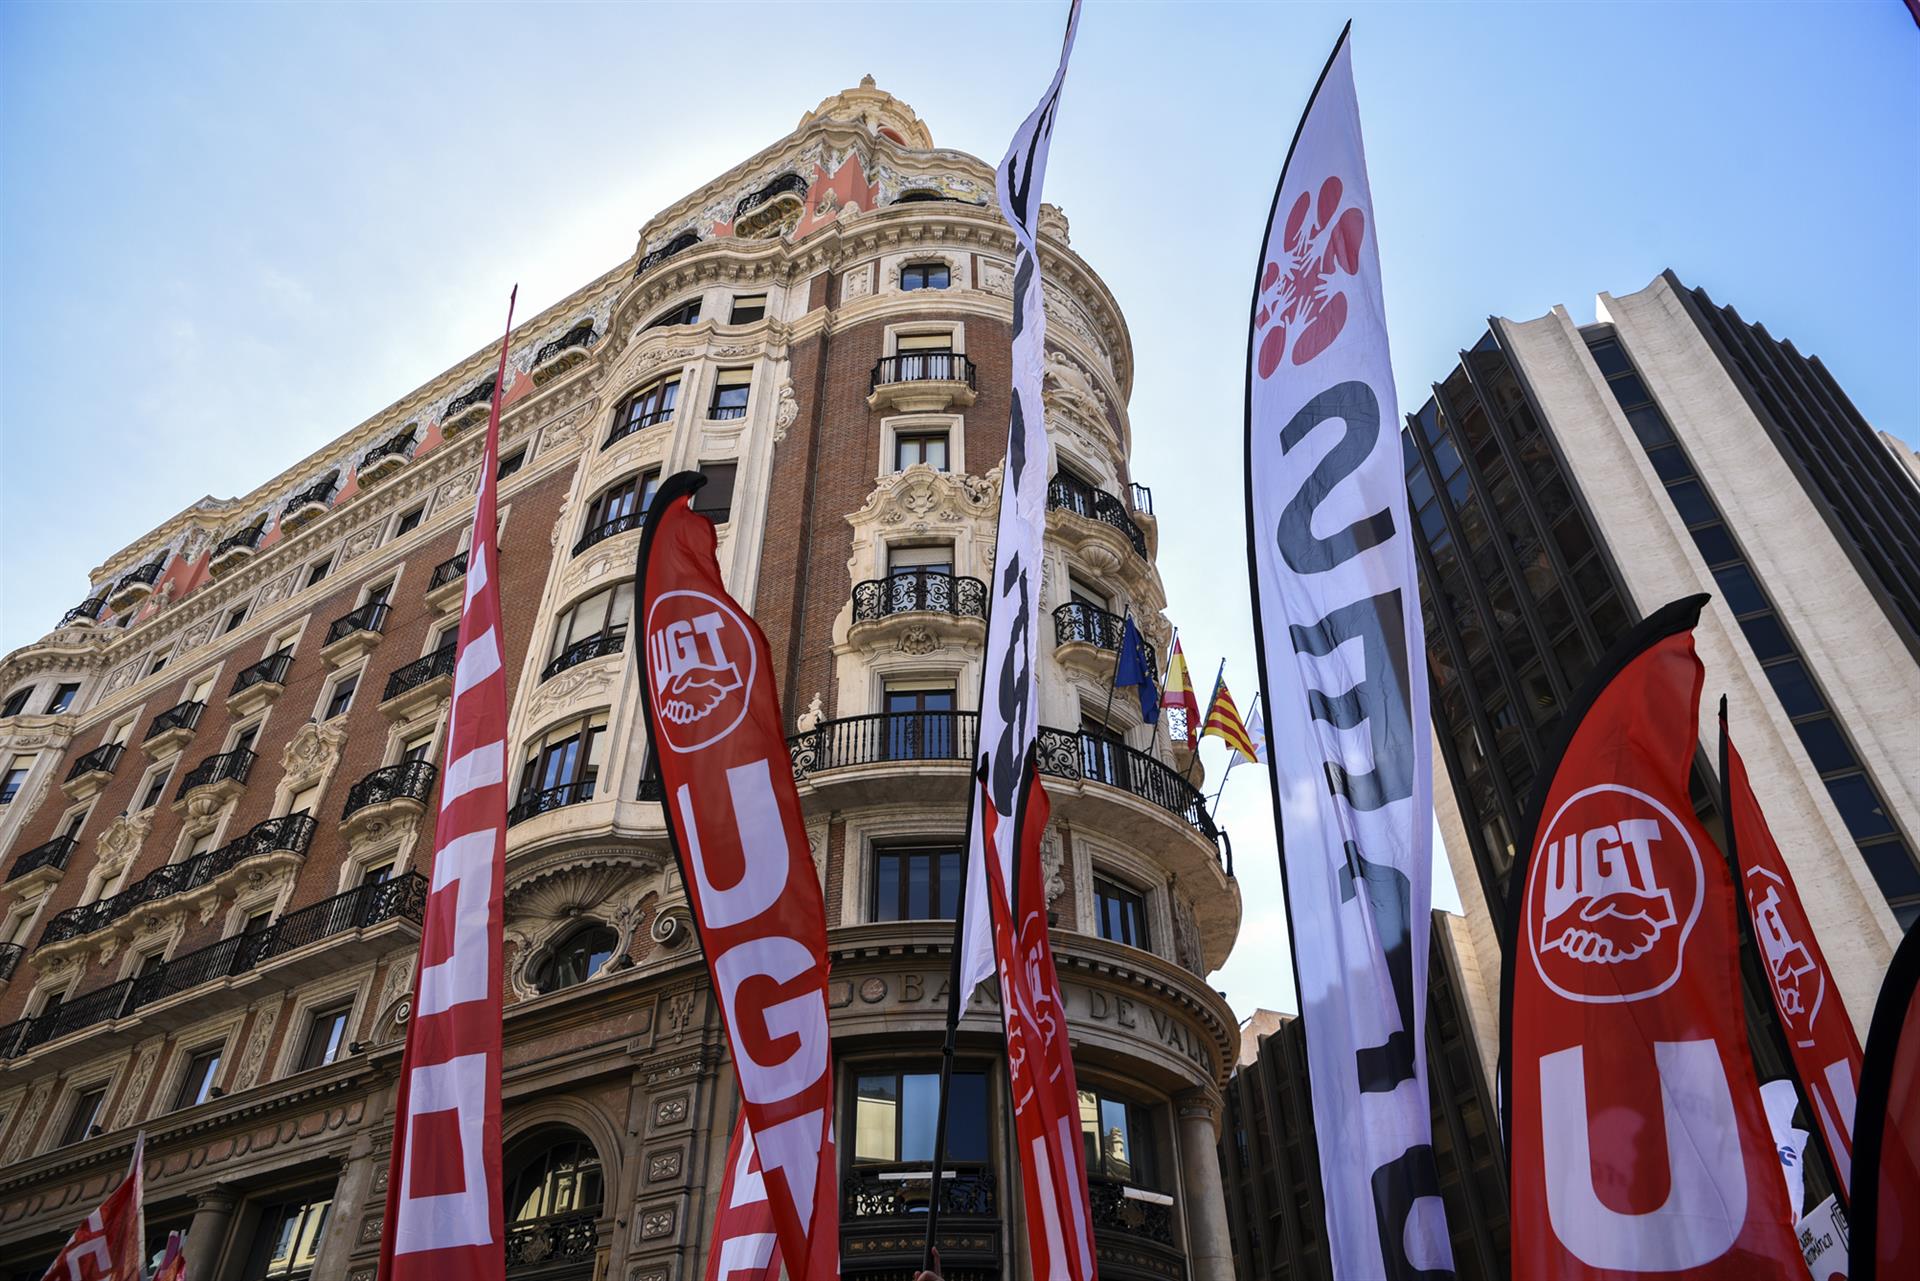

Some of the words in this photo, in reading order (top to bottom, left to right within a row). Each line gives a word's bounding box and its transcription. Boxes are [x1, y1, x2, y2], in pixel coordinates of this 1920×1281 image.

[651, 611, 725, 696] UGT
[1544, 819, 1663, 922] UGT
[677, 758, 828, 1239] UGT
[898, 973, 1067, 1010] BAN
[1089, 989, 1136, 1029] DE
